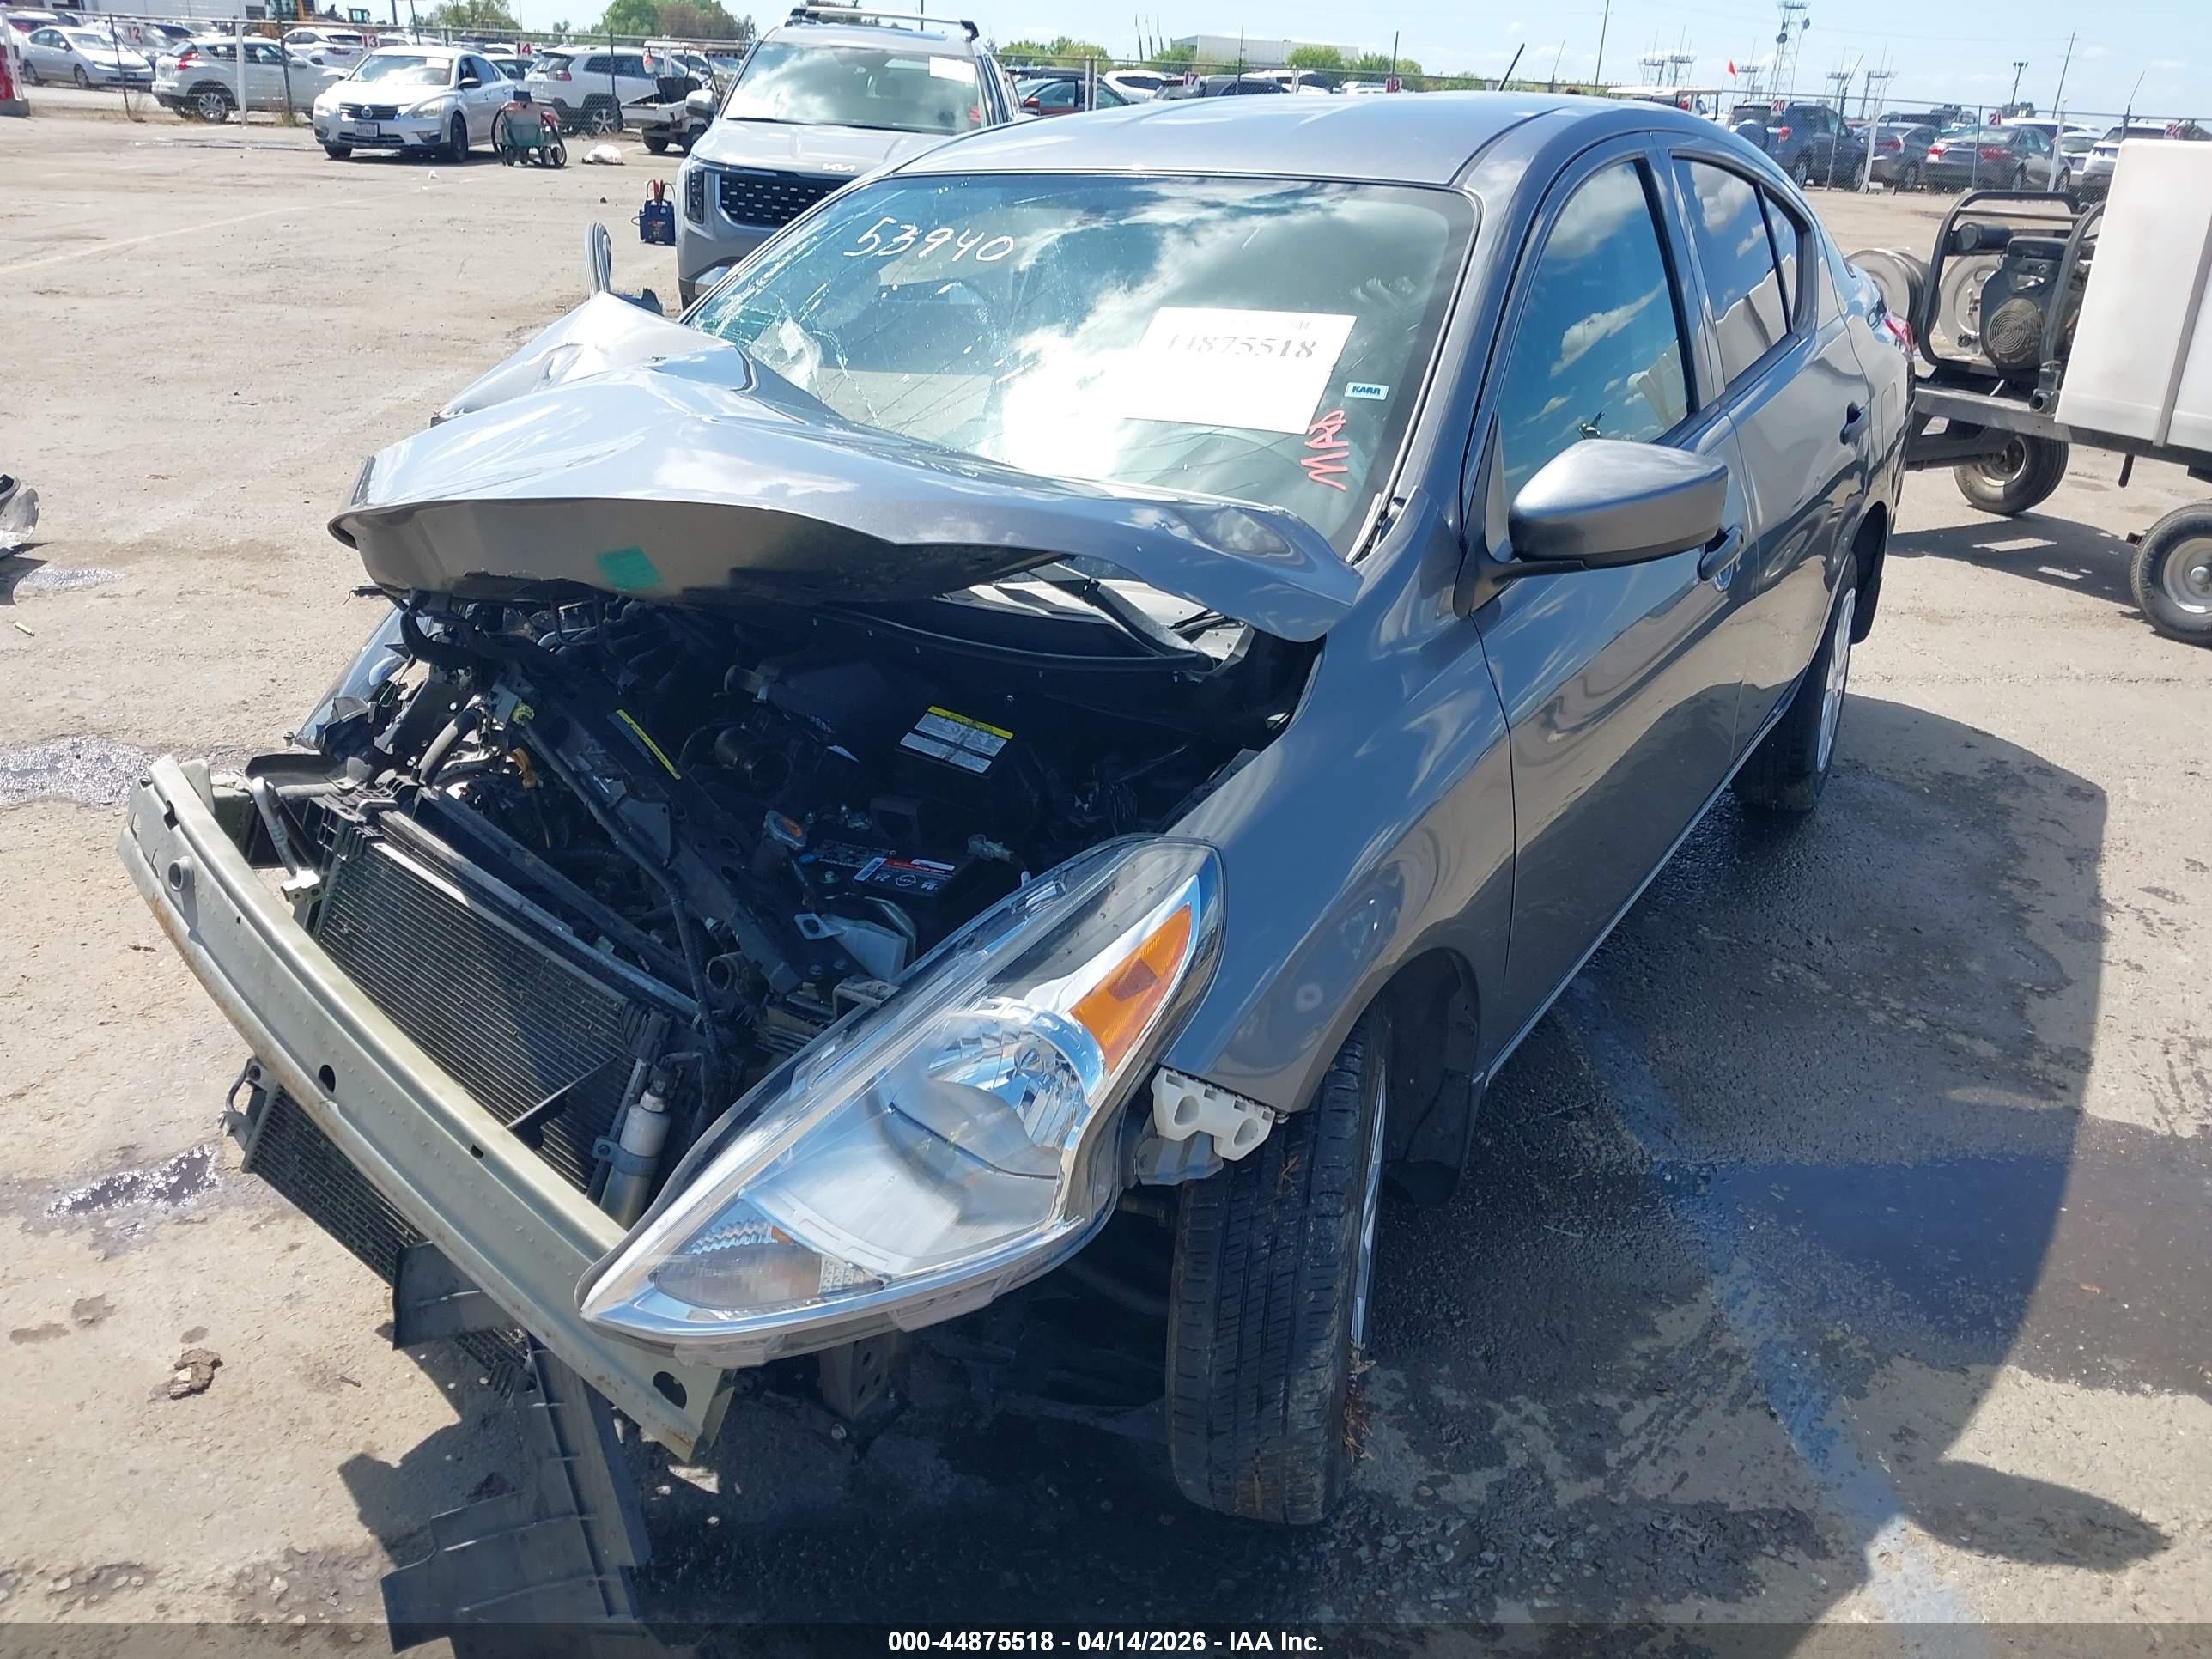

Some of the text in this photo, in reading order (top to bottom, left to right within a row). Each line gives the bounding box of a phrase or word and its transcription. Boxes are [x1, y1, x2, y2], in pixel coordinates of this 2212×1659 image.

[127, 27, 143, 43] 12
[363, 35, 378, 47] 13
[517, 43, 532, 55] 14
[1185, 74, 1199, 85] 17
[1387, 79, 1400, 92] 18
[1772, 100, 1785, 111] 20
[1989, 113, 2001, 125] 21
[843, 217, 1014, 262] 53940
